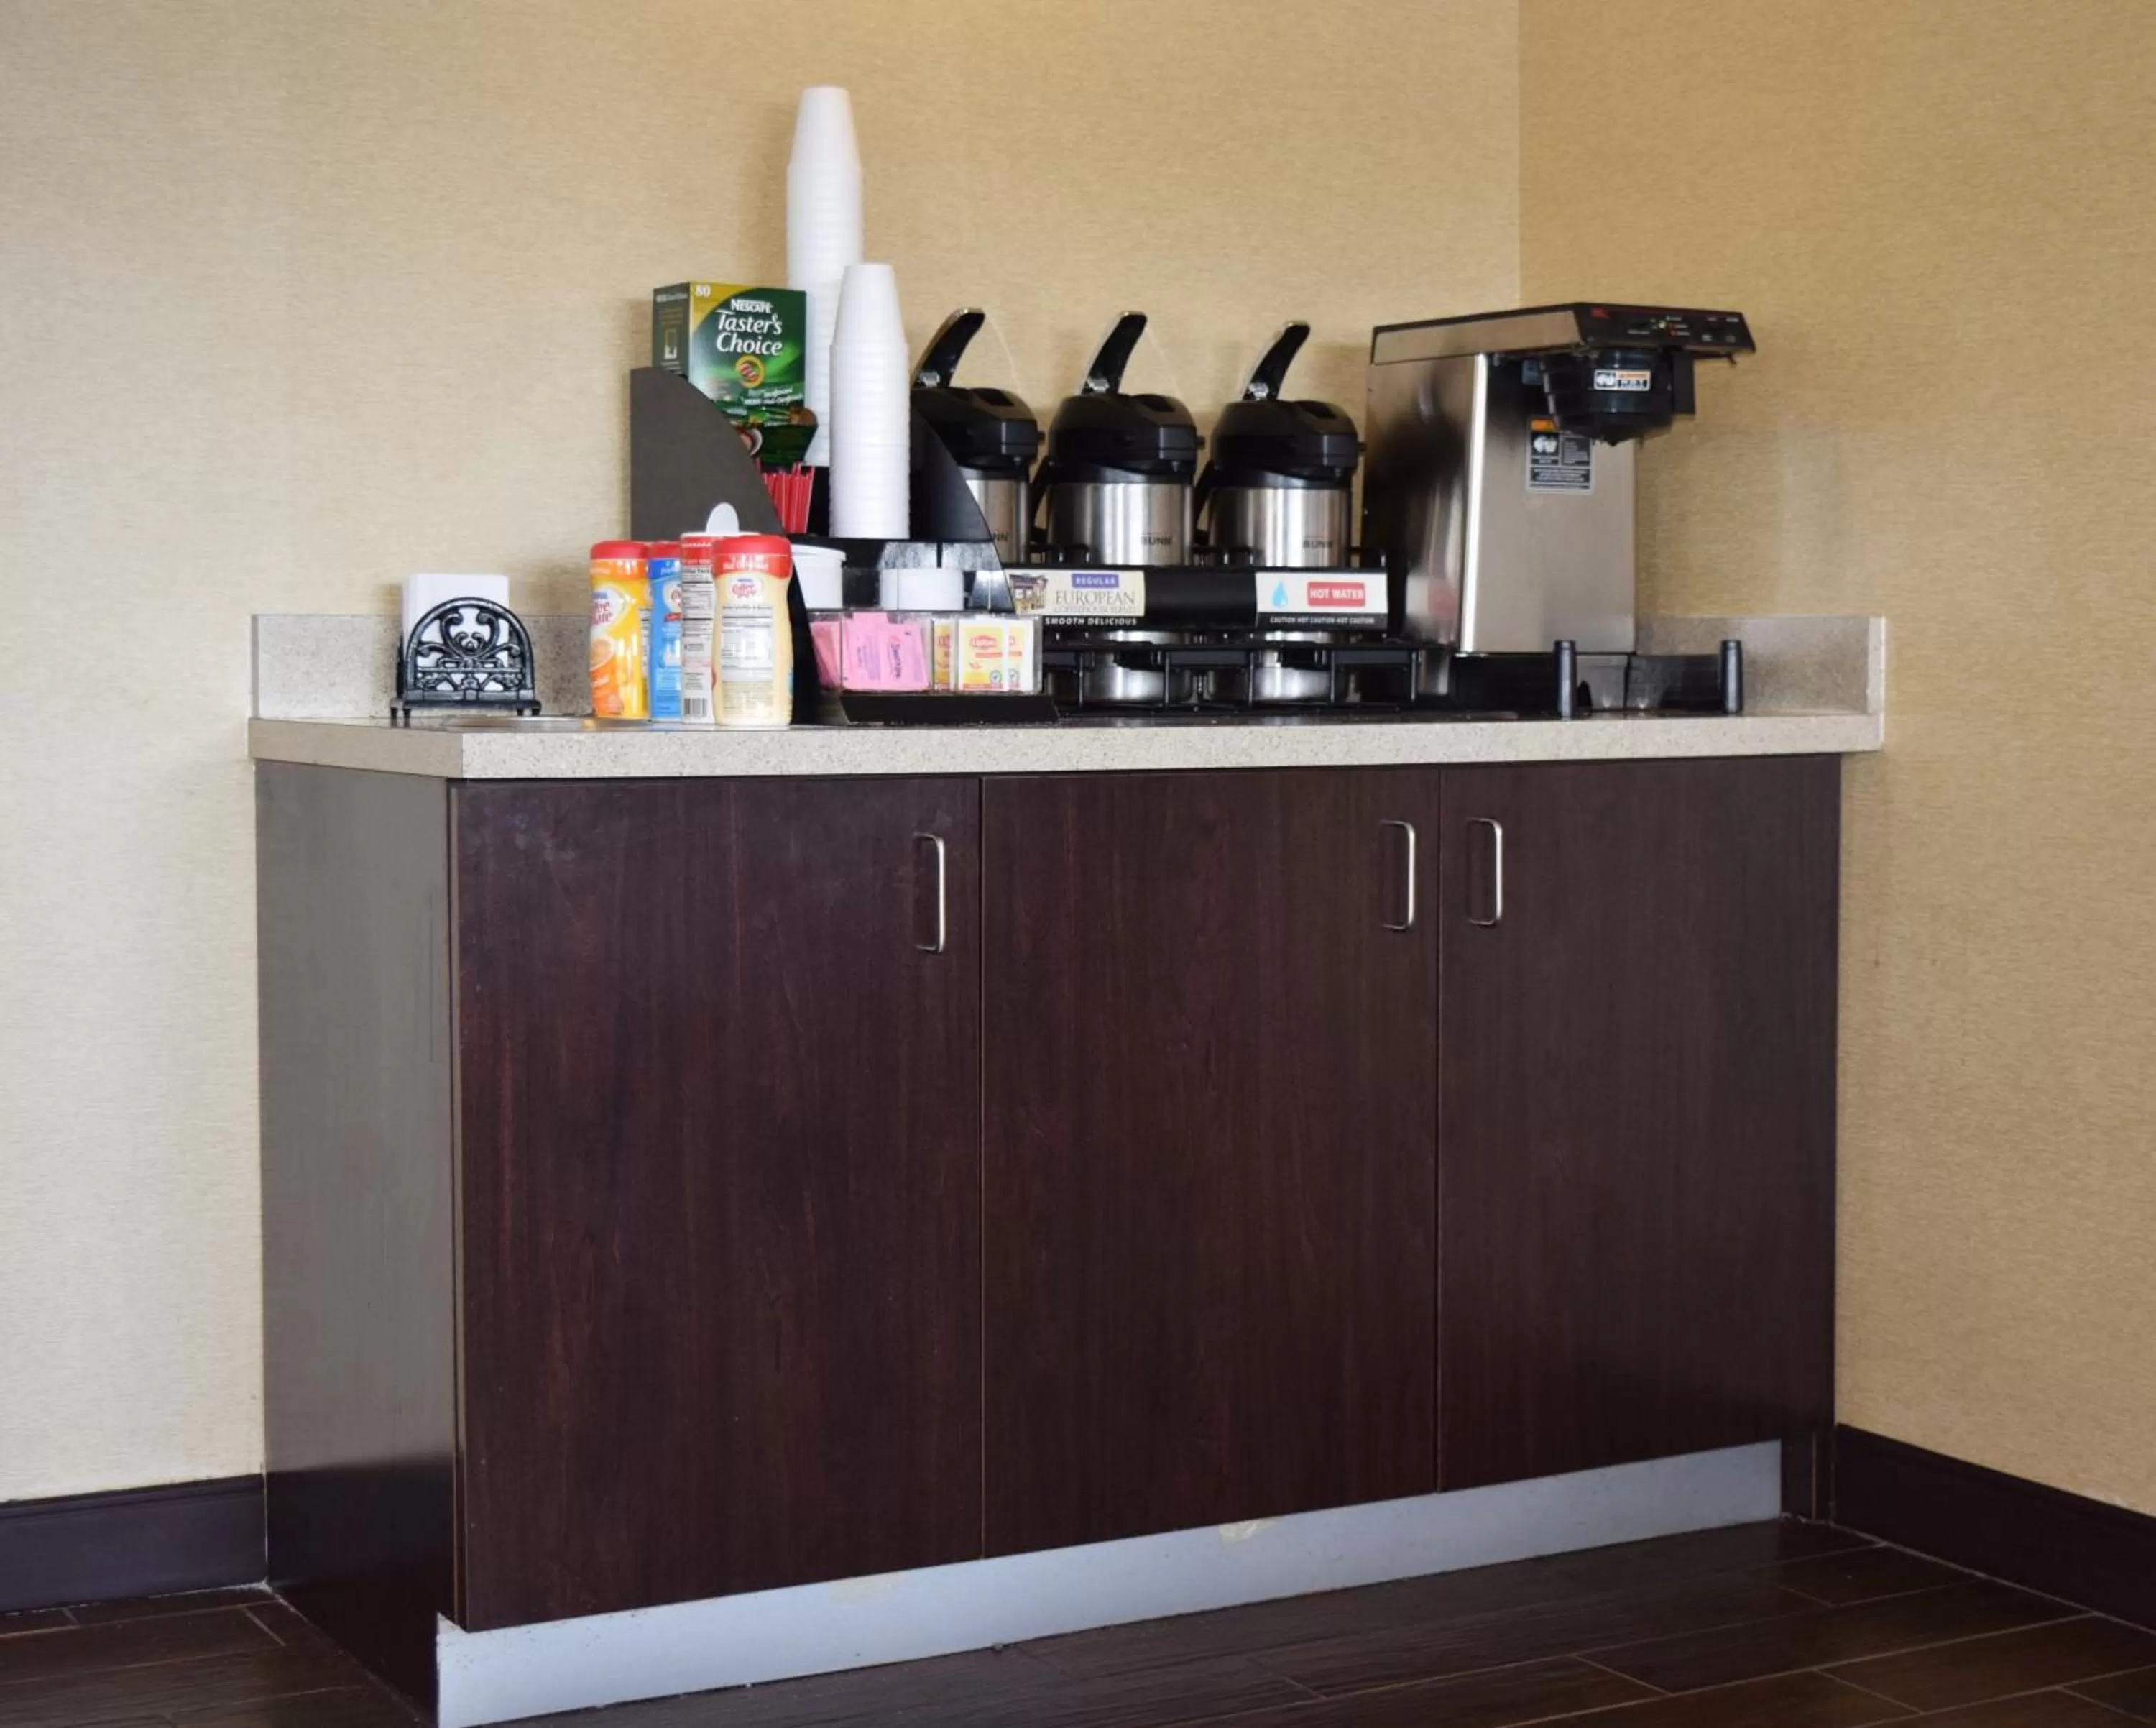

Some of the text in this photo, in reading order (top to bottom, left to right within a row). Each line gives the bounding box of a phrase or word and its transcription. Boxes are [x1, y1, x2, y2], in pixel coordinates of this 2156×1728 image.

[695, 284, 711, 298] 80
[714, 308, 783, 336] Taster's
[716, 331, 783, 356] Choice
[1075, 576, 1116, 586] REGULAR
[1055, 590, 1135, 605] EUROPEAN
[1309, 588, 1364, 599] HOT WATER
[1045, 617, 1138, 626] SMOOTH DELICIOUS
